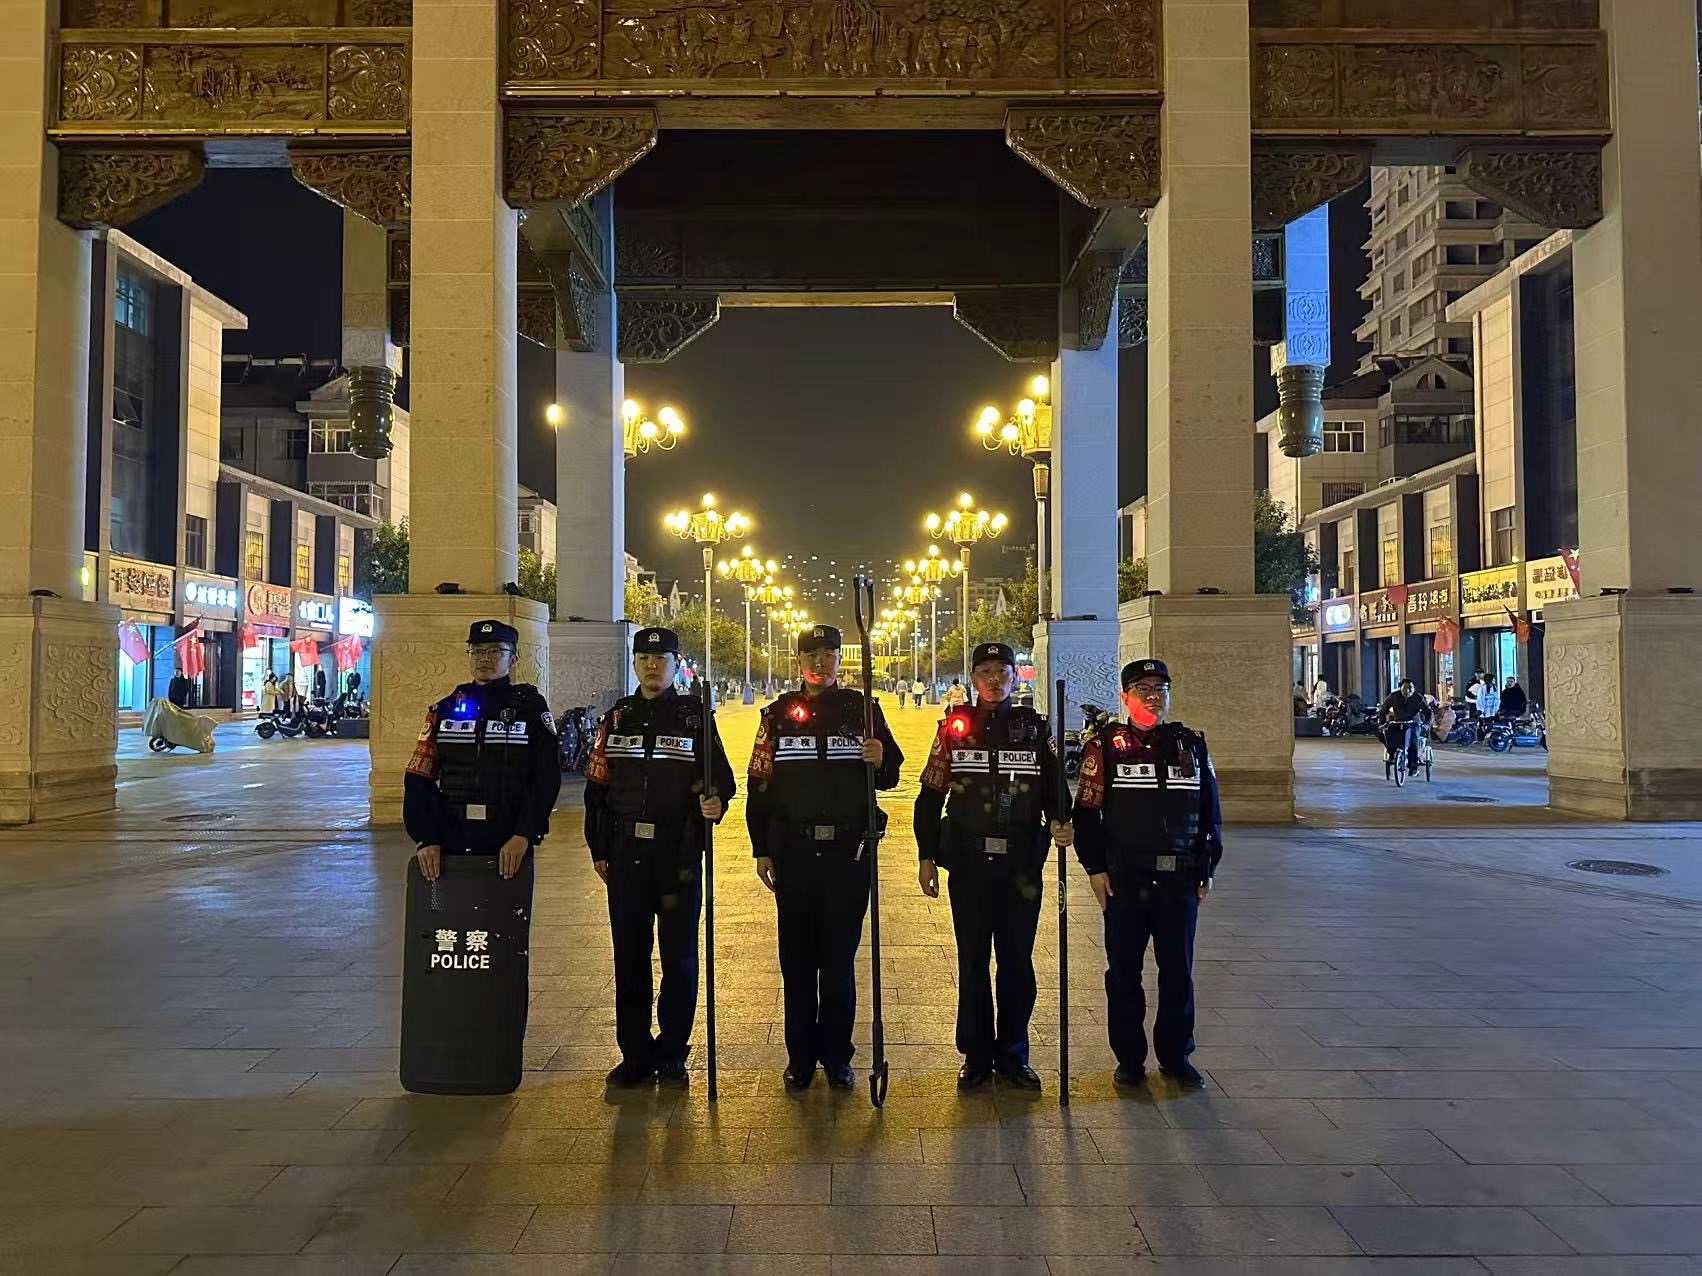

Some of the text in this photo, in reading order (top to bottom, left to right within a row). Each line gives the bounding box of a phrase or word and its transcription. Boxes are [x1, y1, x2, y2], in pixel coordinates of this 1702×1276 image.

[491, 722, 520, 732] POLCE
[660, 737, 688, 749] POLICE
[832, 737, 858, 747] POLIC
[1003, 752, 1031, 762] POLICE
[435, 928, 489, 952] 警察
[431, 953, 490, 969] POLICE
